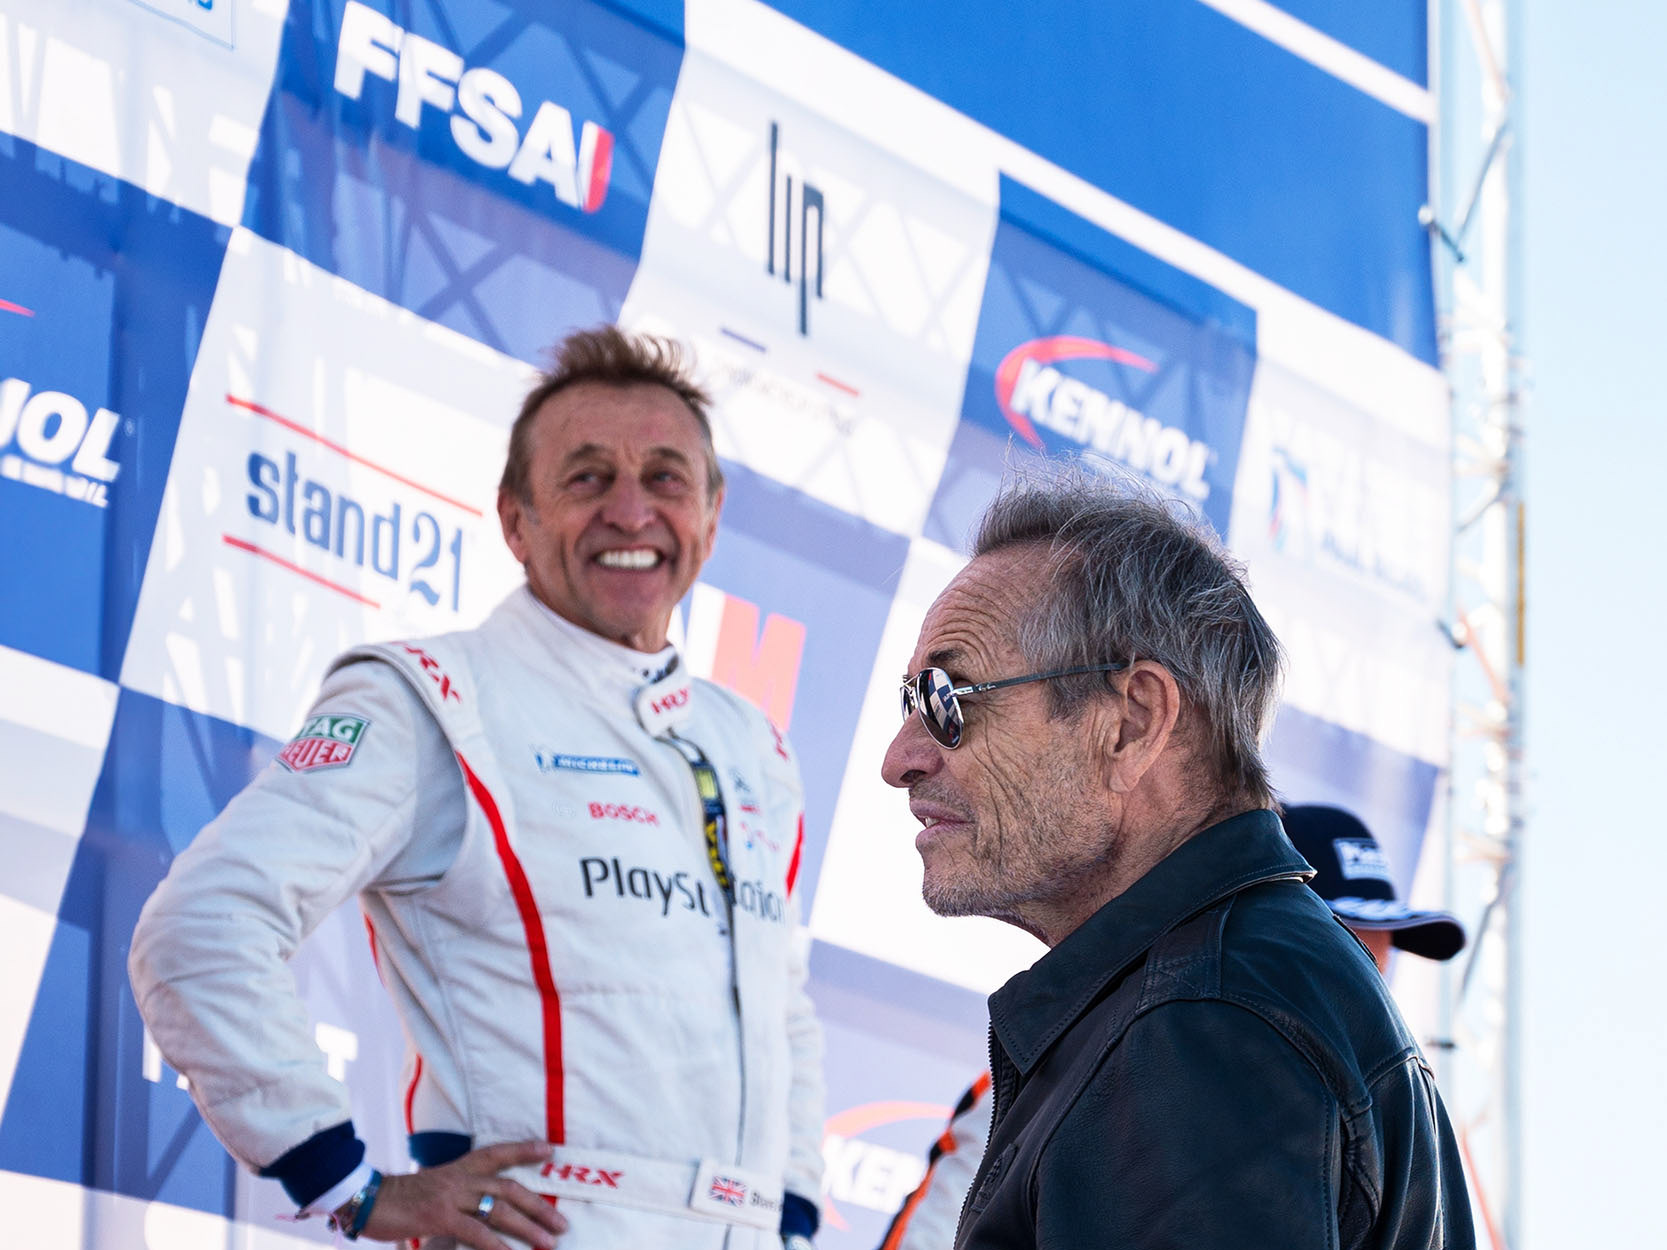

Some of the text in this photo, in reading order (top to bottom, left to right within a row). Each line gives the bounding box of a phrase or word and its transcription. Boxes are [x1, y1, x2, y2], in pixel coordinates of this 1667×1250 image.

[1009, 357, 1210, 498] KENNOL
[301, 717, 359, 742] TAG
[588, 802, 660, 826] BOSCH
[540, 1162, 625, 1189] HRX
[823, 1133, 928, 1215] KE
